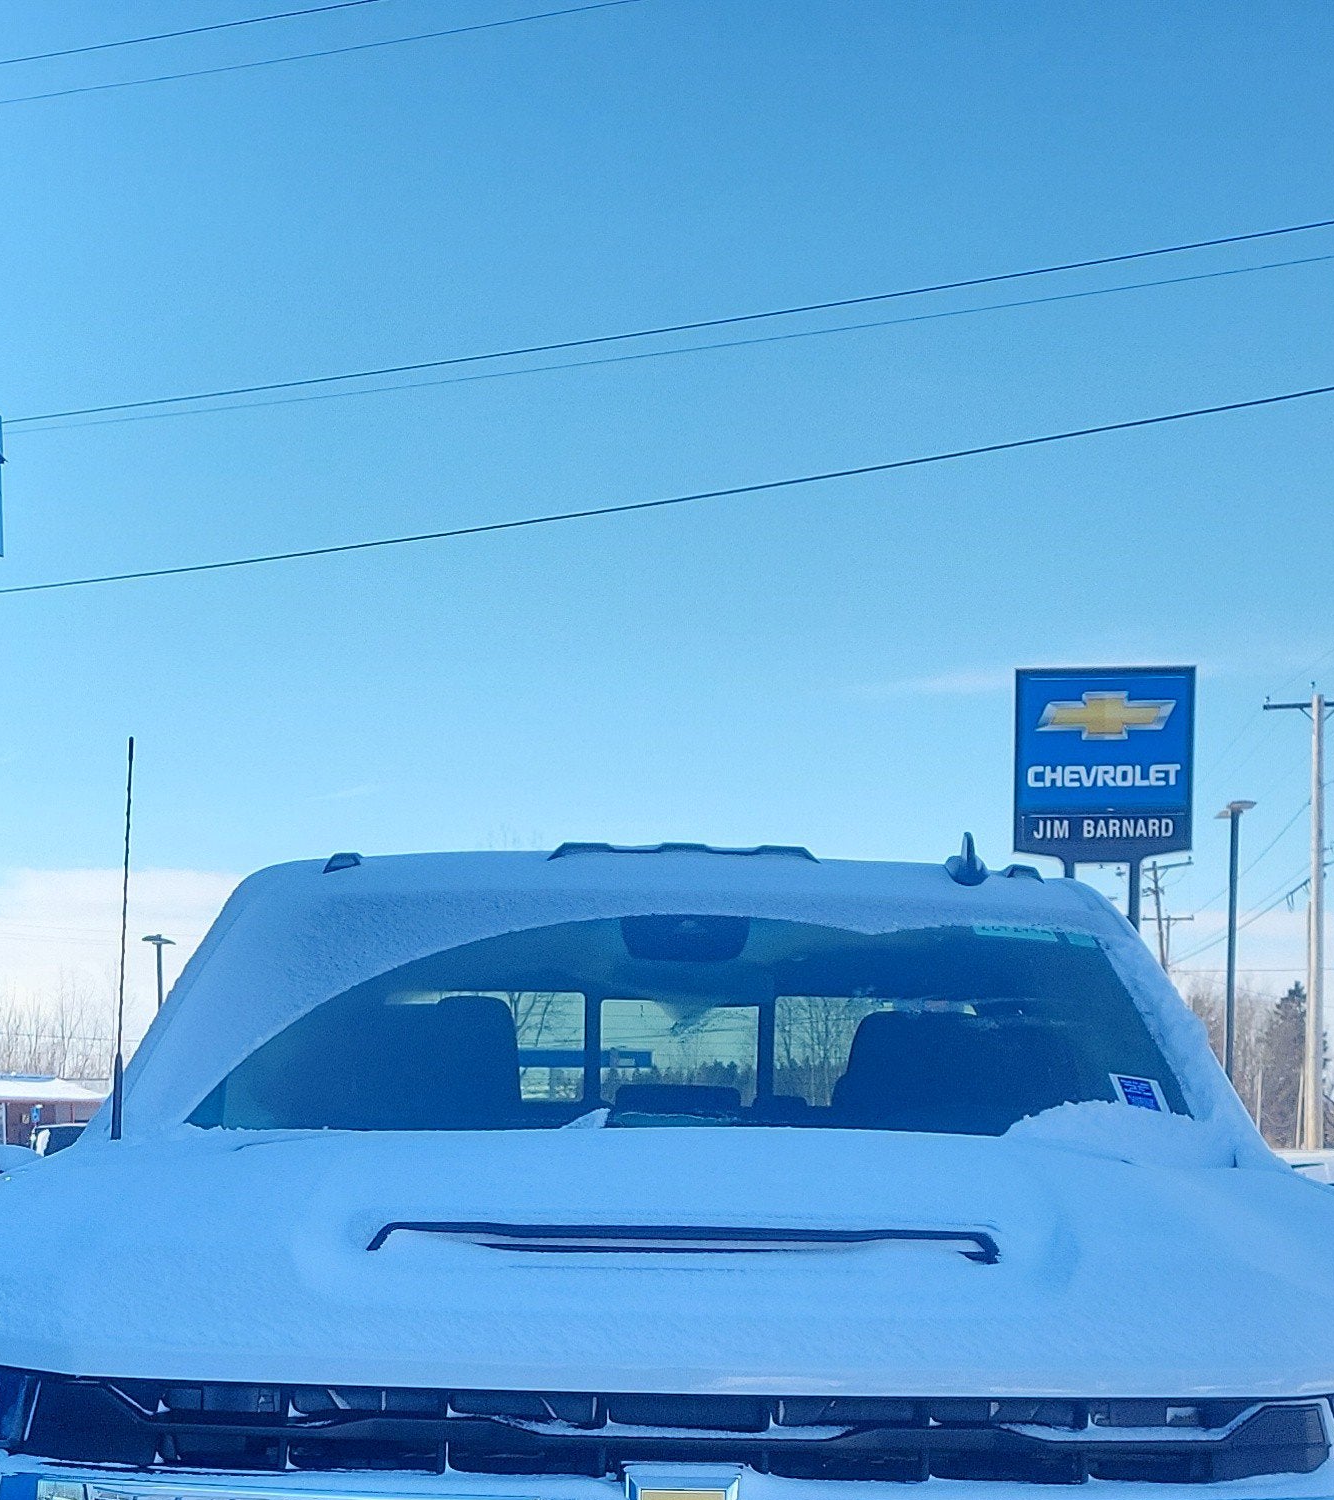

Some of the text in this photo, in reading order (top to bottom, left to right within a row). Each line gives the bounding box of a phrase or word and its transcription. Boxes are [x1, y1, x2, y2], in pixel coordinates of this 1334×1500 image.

[1027, 763, 1181, 787] CHEVROLET
[1033, 818, 1174, 838] JIM BARNARD
